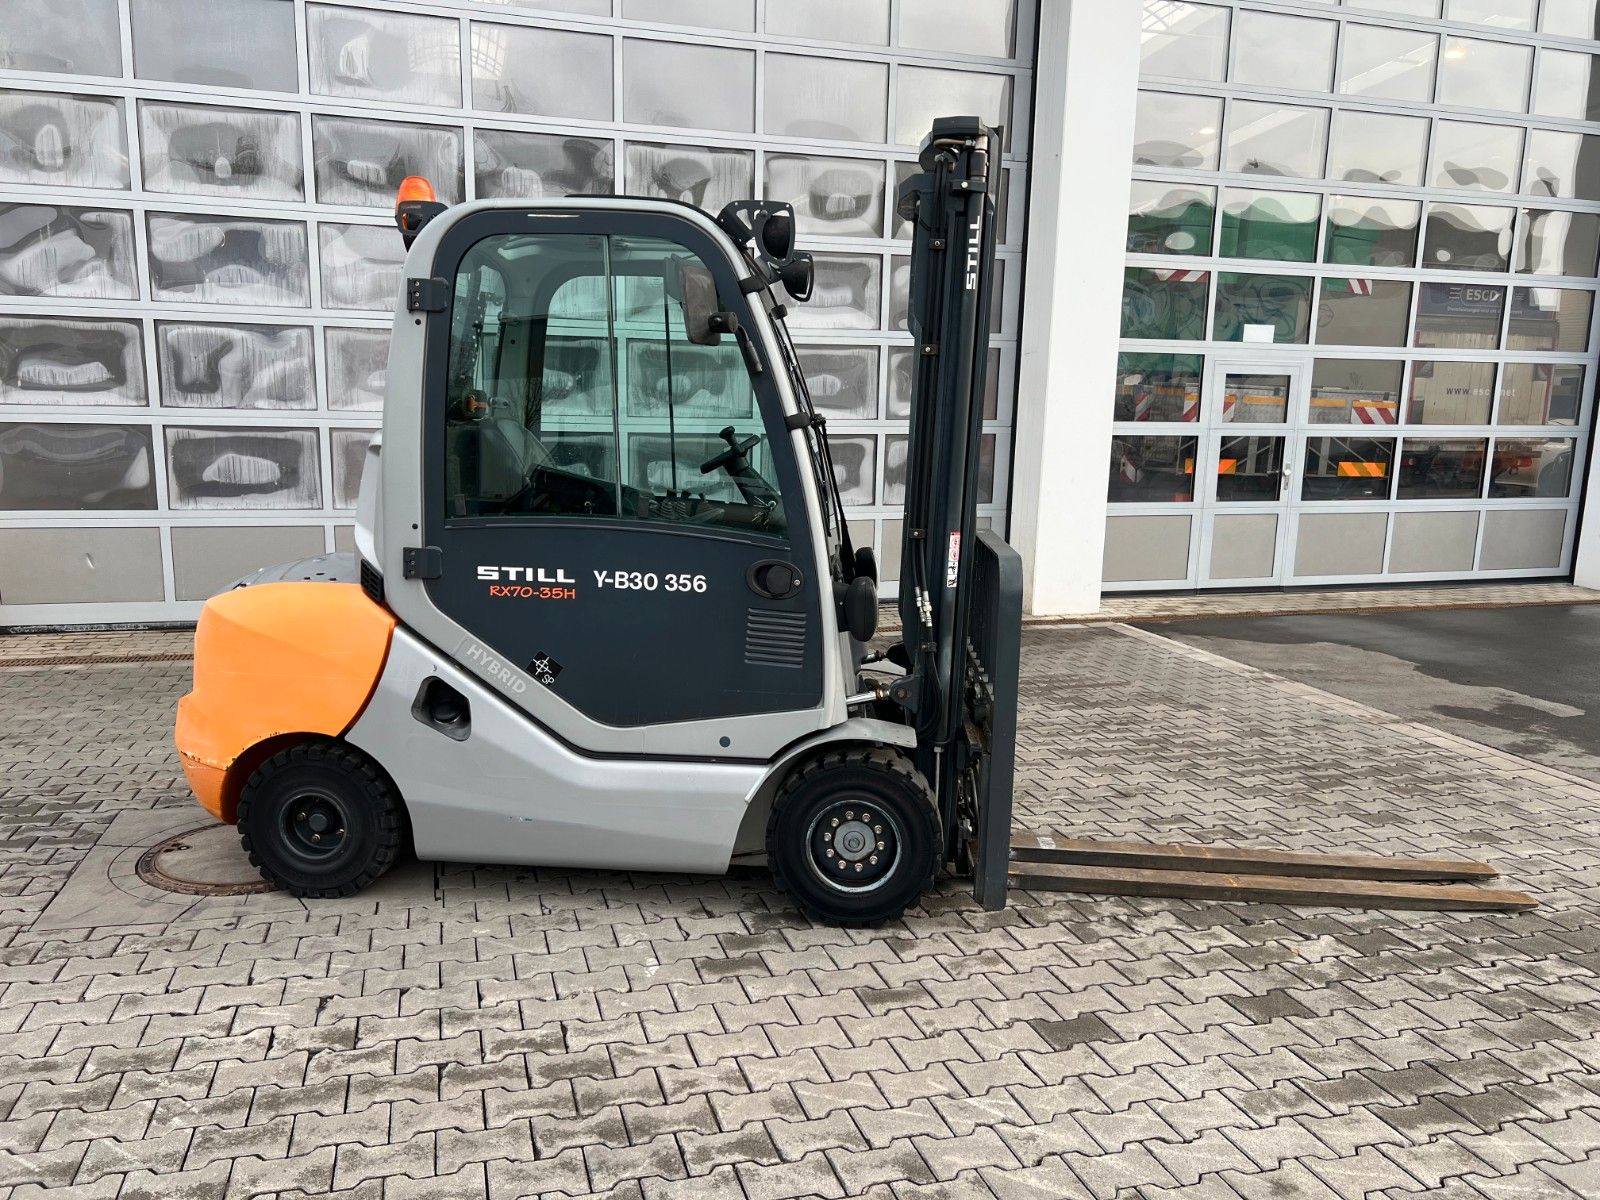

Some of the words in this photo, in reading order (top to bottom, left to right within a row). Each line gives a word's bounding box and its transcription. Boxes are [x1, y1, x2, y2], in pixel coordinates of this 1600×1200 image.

[965, 215, 981, 290] STILL
[477, 565, 576, 584] STILL
[593, 570, 659, 591] Y-B30
[664, 573, 708, 593] 356
[489, 584, 577, 600] RX70-35H
[465, 644, 528, 695] HYBRID
[541, 673, 555, 685] SP
